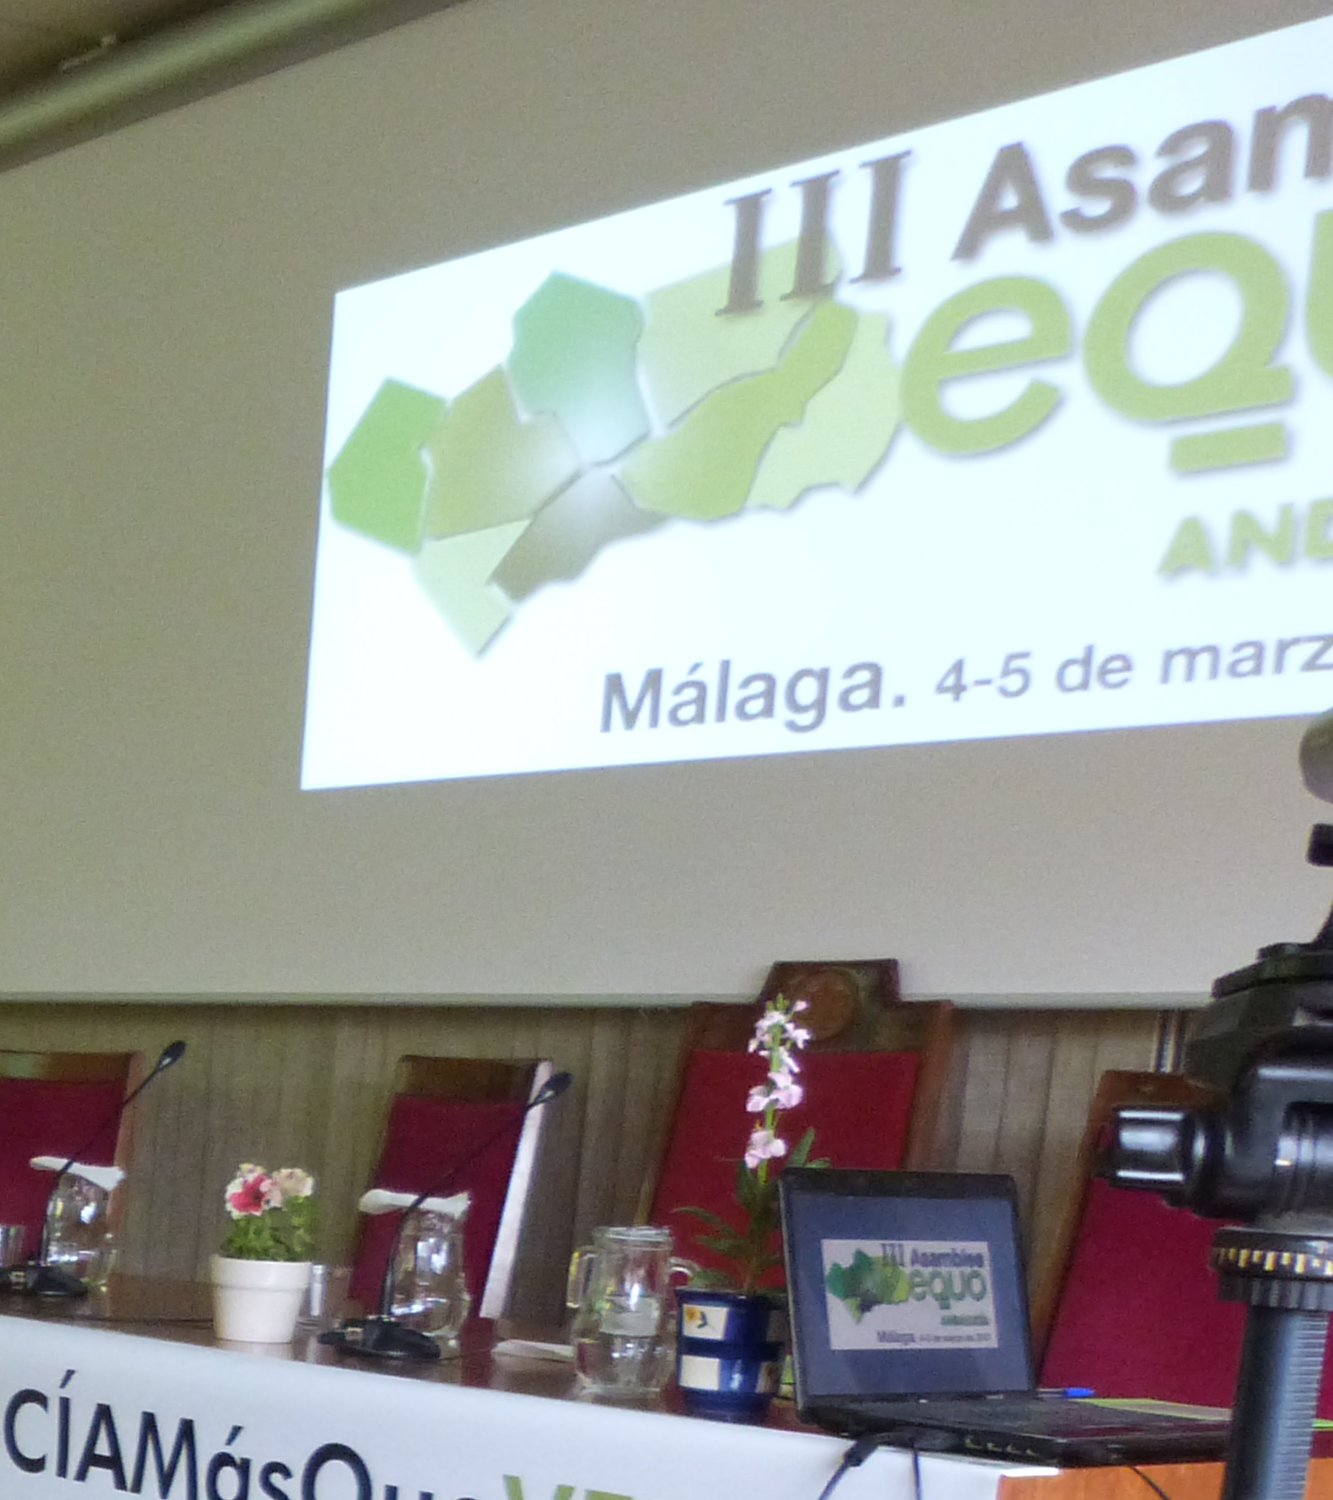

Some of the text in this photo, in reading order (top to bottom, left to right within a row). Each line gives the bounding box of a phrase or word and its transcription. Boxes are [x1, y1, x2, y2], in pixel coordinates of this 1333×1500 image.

[719, 151, 911, 317] III
[599, 659, 906, 734] Málaga.
[935, 652, 1033, 702] 4-5
[1055, 646, 1133, 692] de
